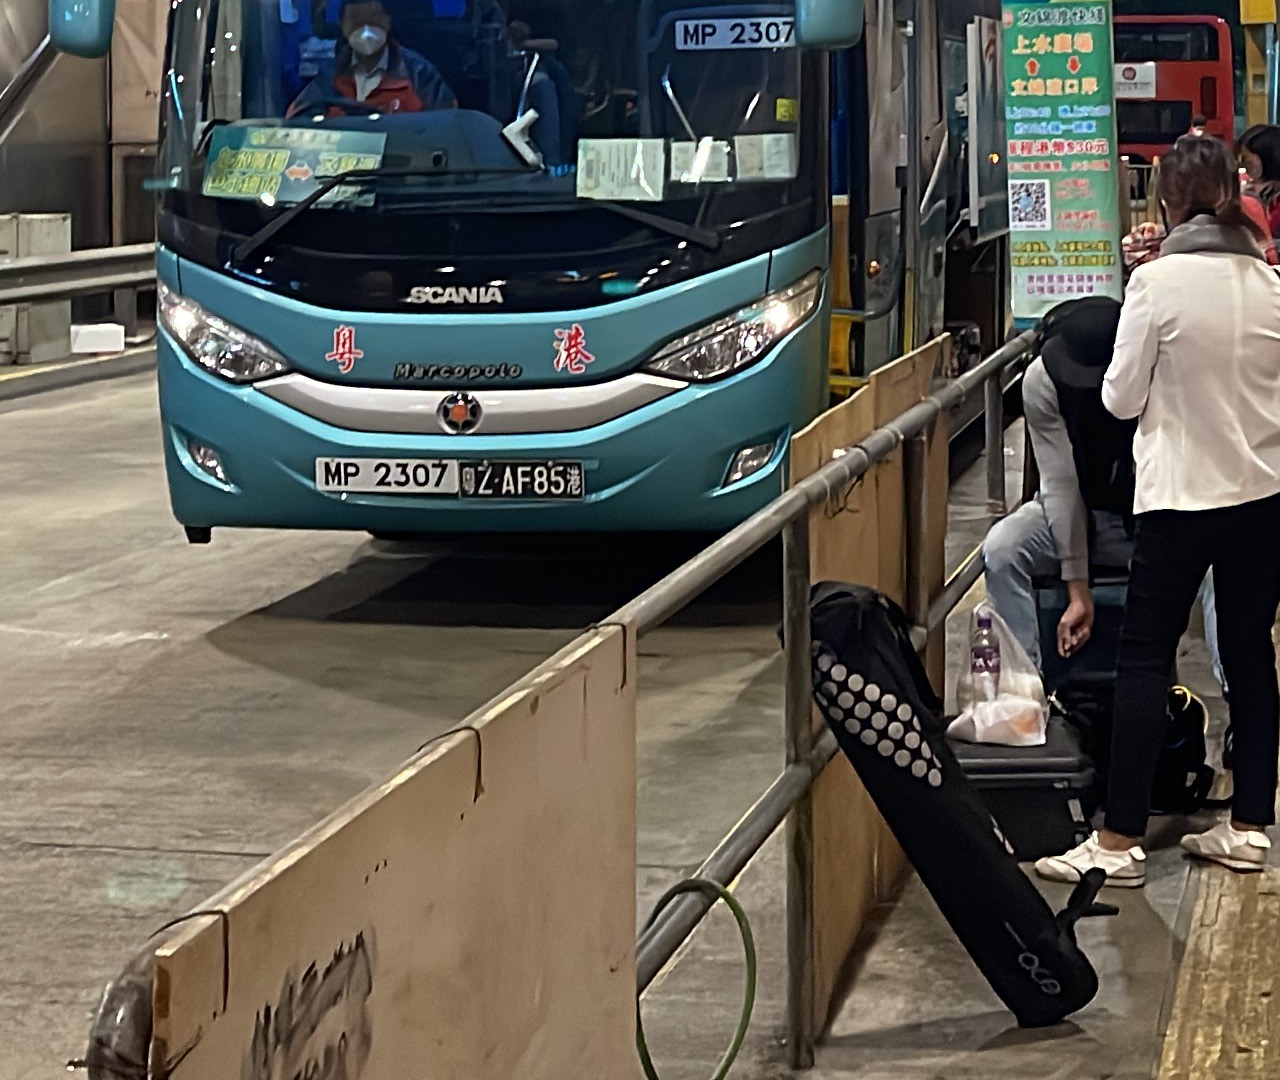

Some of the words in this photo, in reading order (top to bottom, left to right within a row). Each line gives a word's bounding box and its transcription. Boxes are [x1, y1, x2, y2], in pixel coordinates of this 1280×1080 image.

[683, 24, 716, 46] MP
[729, 22, 795, 45] 2307
[409, 286, 503, 304] SCANIA
[553, 323, 595, 374] 港
[393, 362, 523, 380] Marcopolo
[323, 462, 360, 487] MP
[374, 462, 449, 488] 2307
